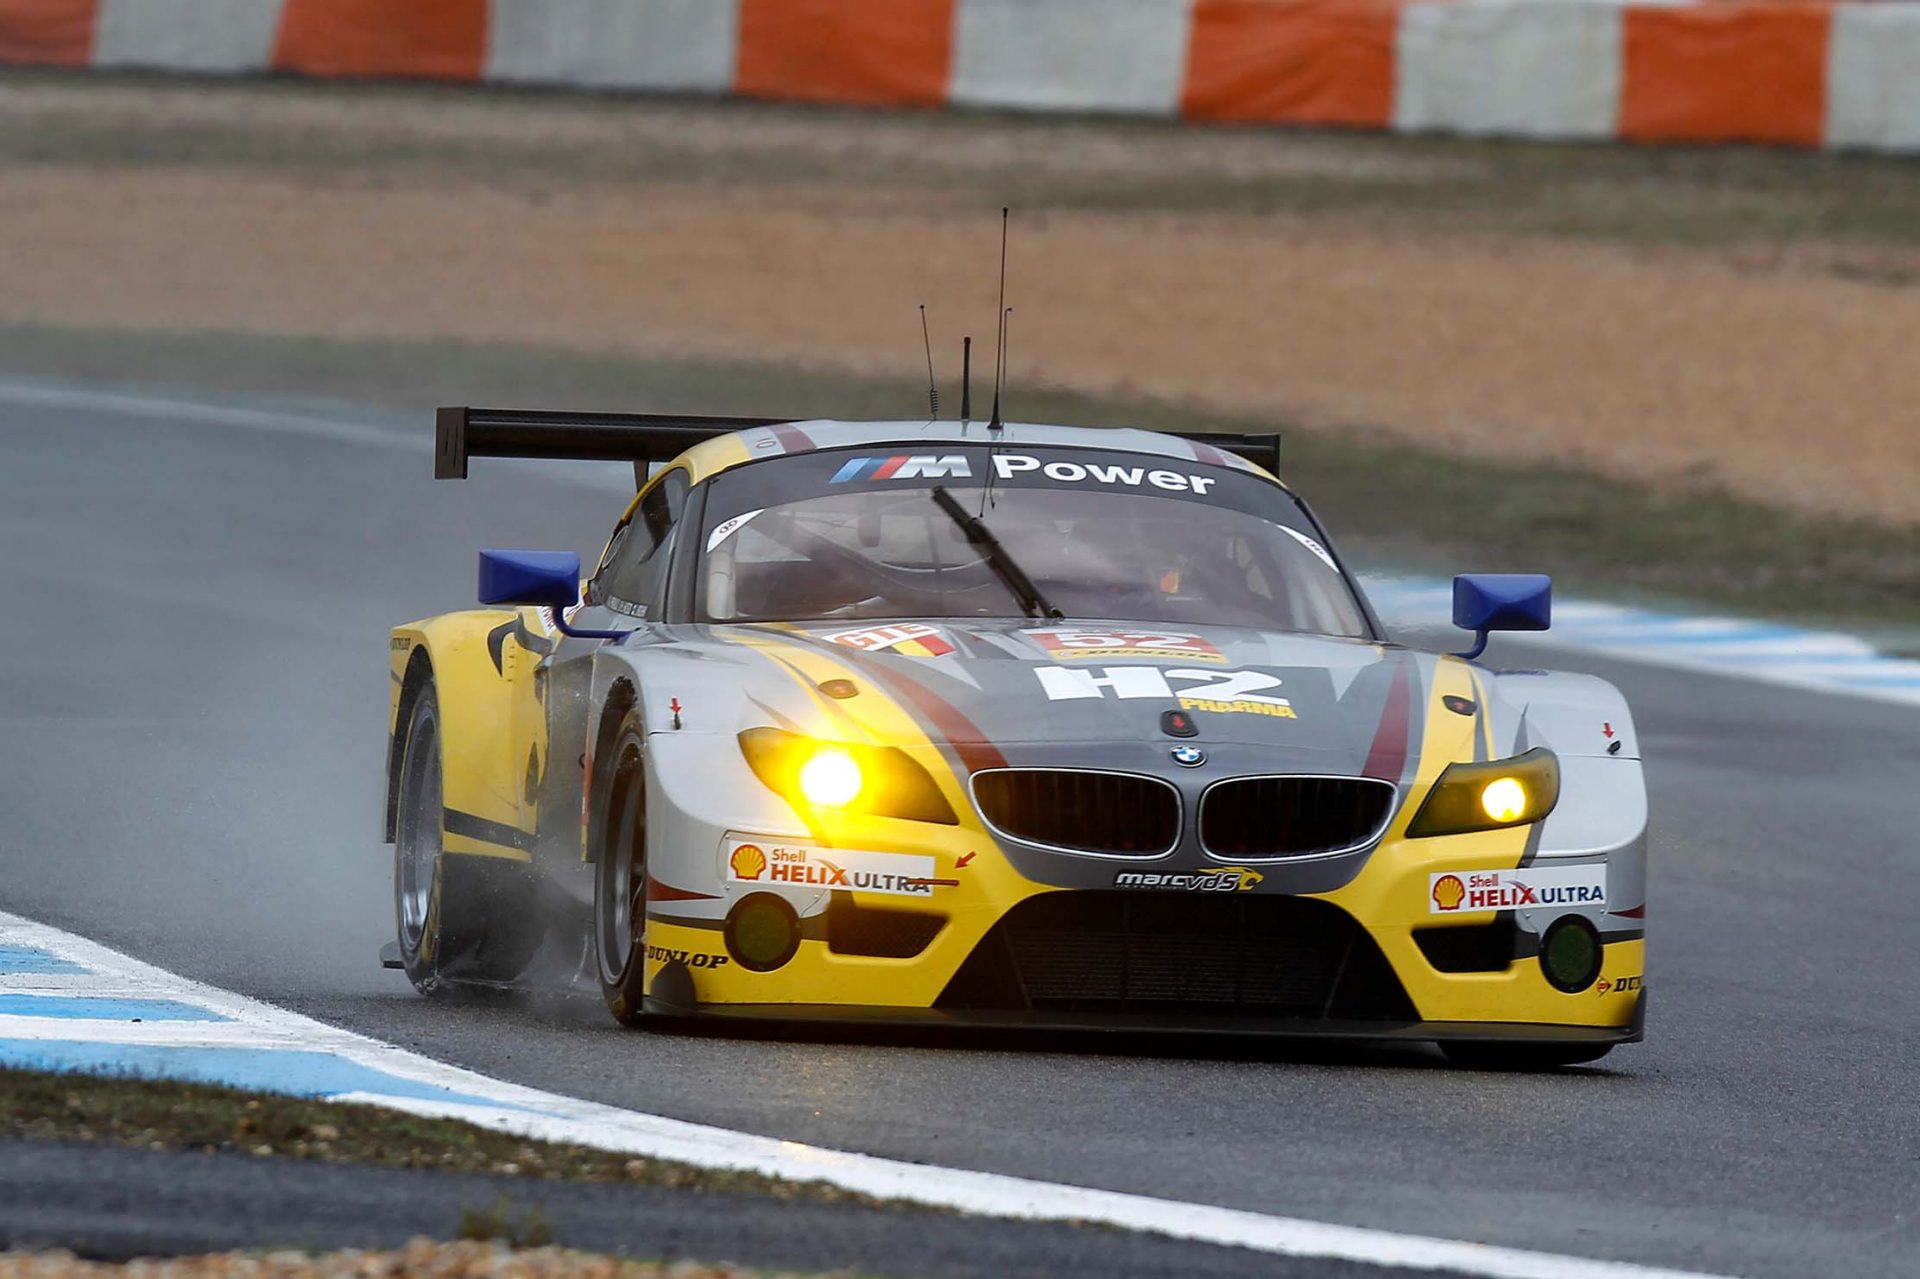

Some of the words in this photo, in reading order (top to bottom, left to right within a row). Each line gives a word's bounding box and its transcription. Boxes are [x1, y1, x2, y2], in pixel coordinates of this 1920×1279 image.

[992, 454, 1216, 495] Power
[1054, 631, 1203, 650] 52
[1034, 666, 1291, 706] H2
[1179, 698, 1297, 720] PHARMA
[771, 848, 807, 863] Shell
[770, 861, 849, 886] HELIX
[853, 871, 930, 893] ULTRA
[1469, 873, 1499, 888] Shell
[1469, 886, 1538, 908] HELIX
[1540, 886, 1604, 904] ULTRA
[648, 946, 729, 969] DUNLOP
[1613, 976, 1643, 992] DU
